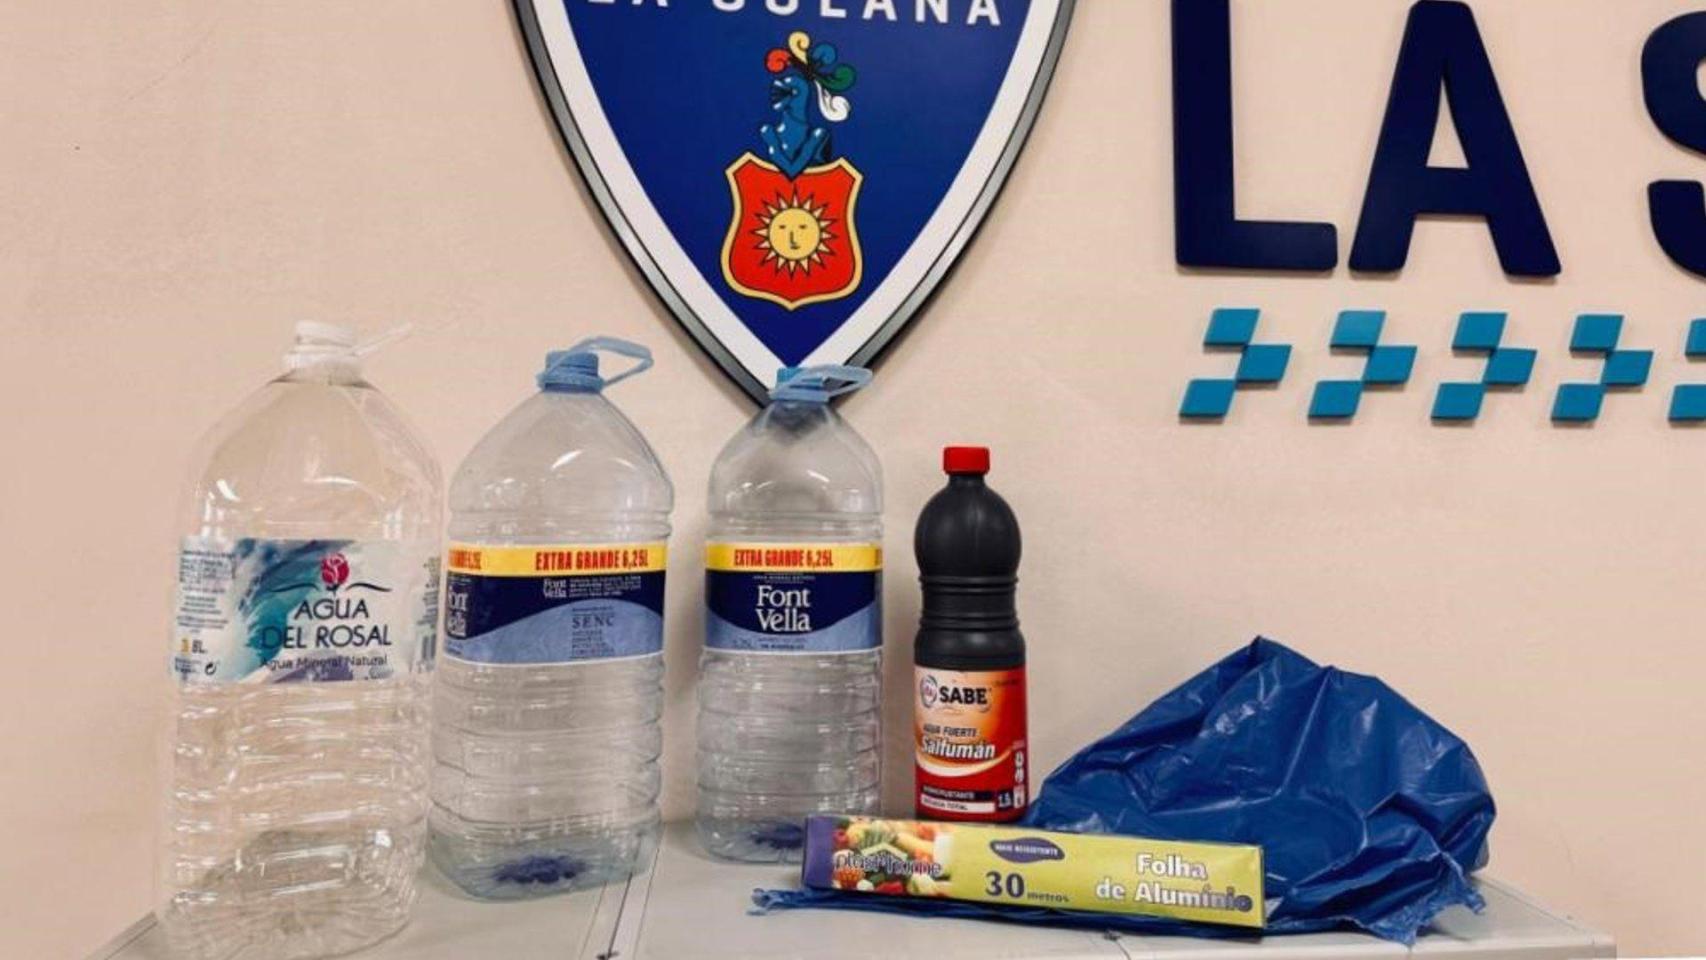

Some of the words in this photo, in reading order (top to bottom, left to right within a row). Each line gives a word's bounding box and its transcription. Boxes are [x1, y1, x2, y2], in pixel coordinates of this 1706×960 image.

[1171, 0, 1562, 276] LA
[535, 551, 572, 570] EXTRA
[576, 550, 620, 569] GRANDE
[734, 549, 762, 566] EXTRA
[765, 549, 804, 566] GRANDE
[756, 584, 811, 608] Font
[294, 598, 369, 621] AGUA
[755, 608, 812, 633] Vella
[262, 626, 308, 650] DEL
[316, 625, 392, 649] ROSAL
[261, 658, 293, 671] Agua
[297, 655, 343, 669] Mineral
[347, 654, 388, 667] Natural
[939, 687, 988, 705] SABE
[1136, 853, 1208, 880] Folha
[985, 870, 1025, 898] 30
[1027, 892, 1070, 903] metros
[1096, 877, 1125, 900] de
[1134, 882, 1253, 913] Alumínio
